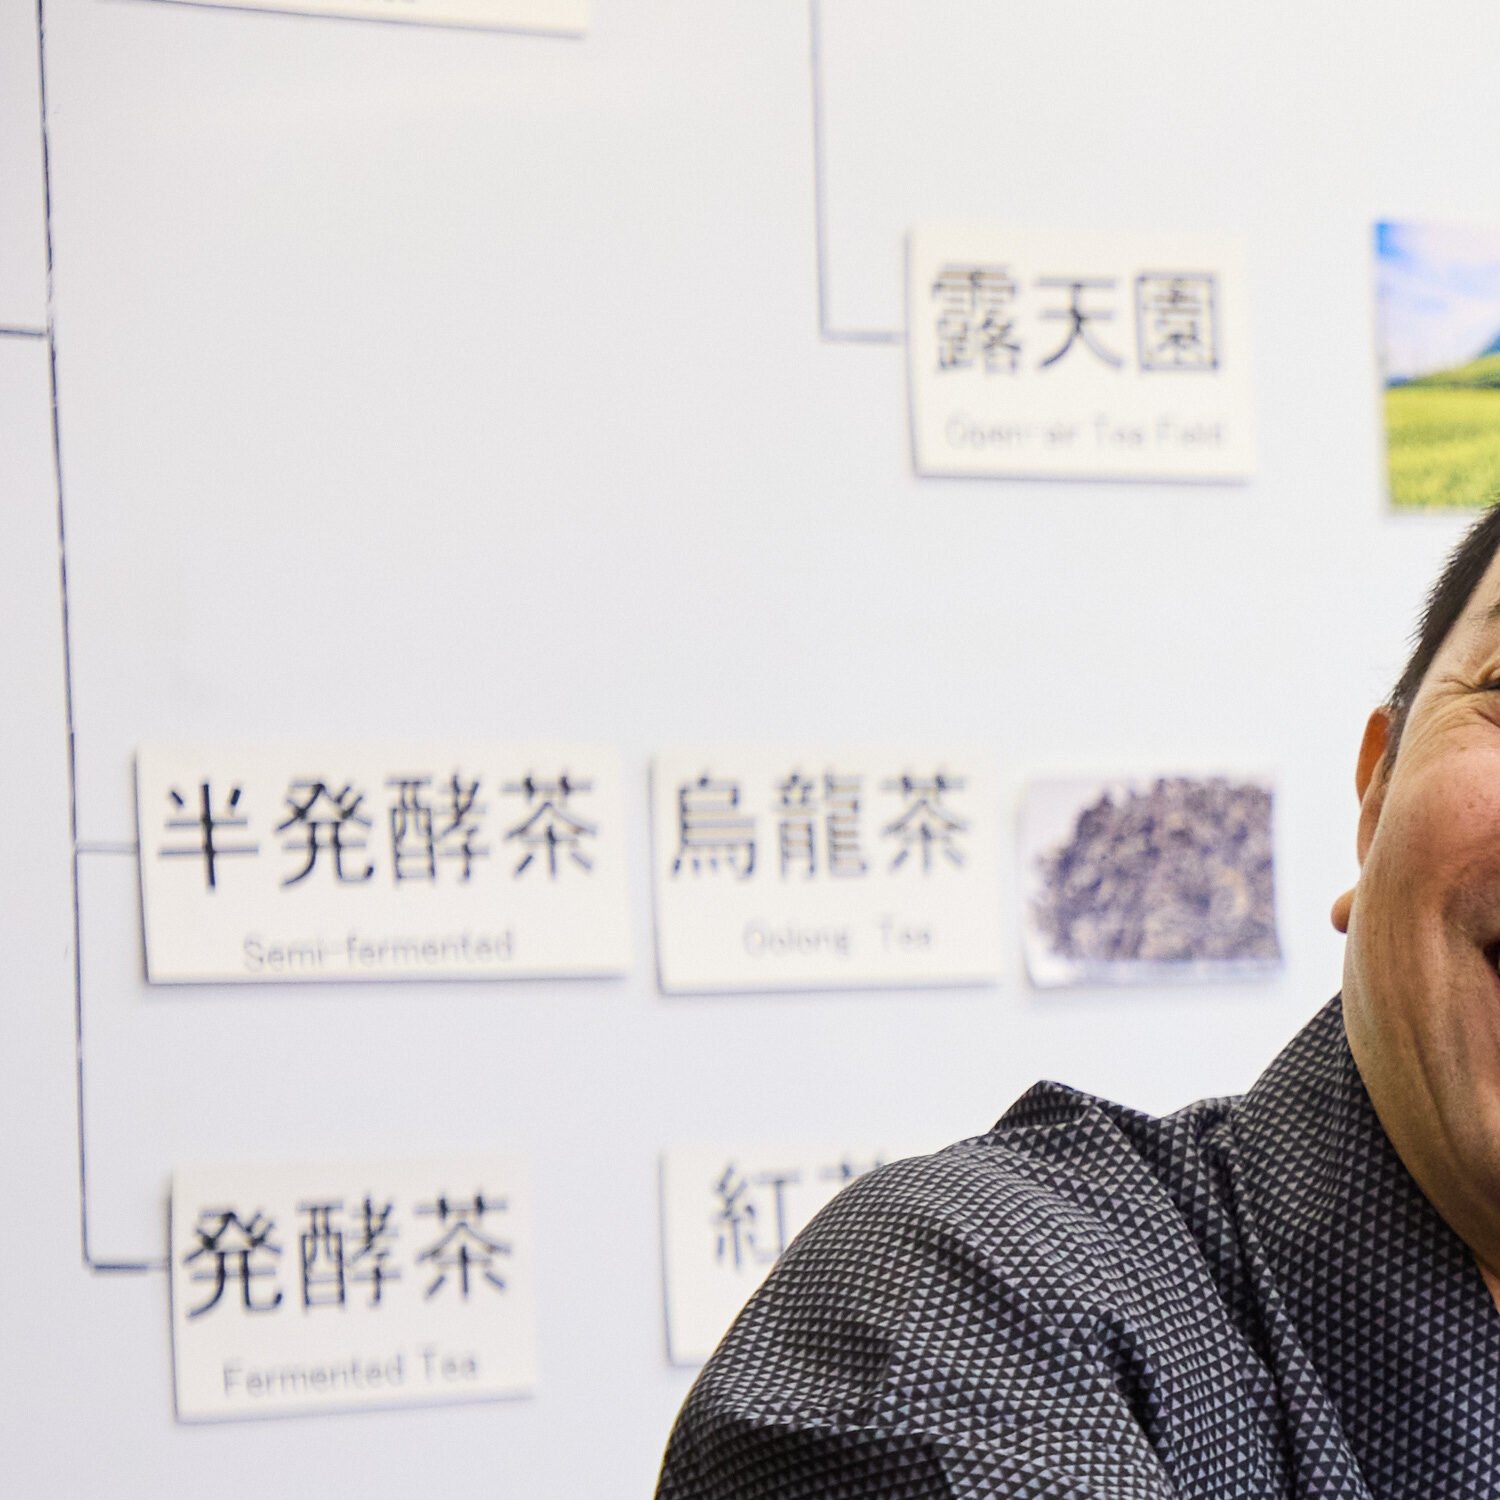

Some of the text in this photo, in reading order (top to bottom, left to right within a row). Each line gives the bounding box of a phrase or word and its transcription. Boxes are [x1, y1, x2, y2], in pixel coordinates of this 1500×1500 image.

[932, 263, 1221, 375] 露天園
[158, 768, 596, 893] 半発酵茶
[243, 930, 514, 970] Semi-fermented
[877, 915, 934, 949] Tea
[183, 1190, 512, 1320] 発酵茶
[222, 1344, 482, 1399] Fermented Tea
